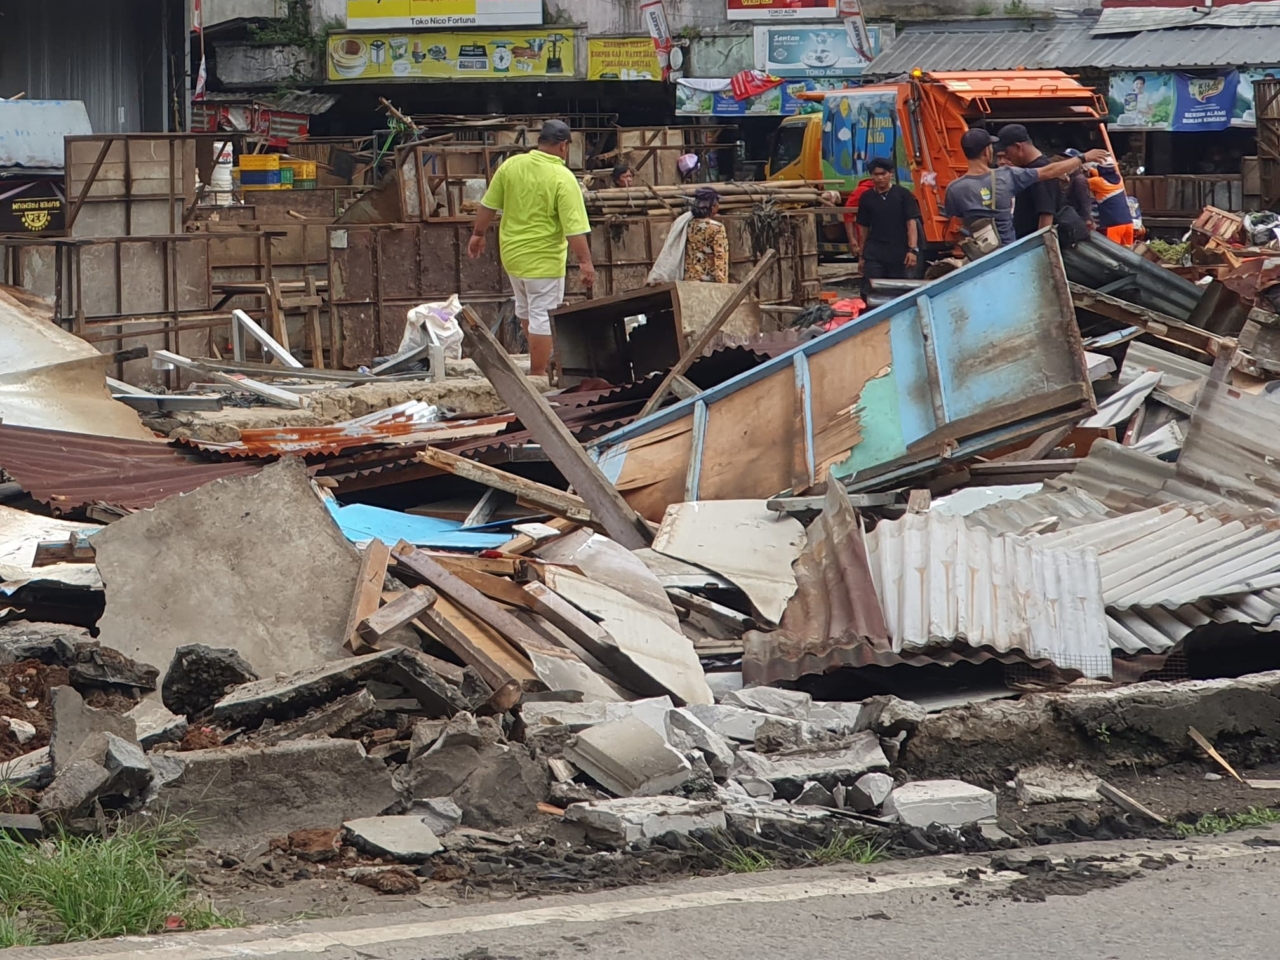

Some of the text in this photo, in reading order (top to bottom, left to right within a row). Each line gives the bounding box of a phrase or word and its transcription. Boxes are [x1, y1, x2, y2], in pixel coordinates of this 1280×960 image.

[410, 16, 476, 25] Toko Nico Fortuna
[12, 202, 39, 210] PREMIUM
[28, 213, 45, 223] 234
